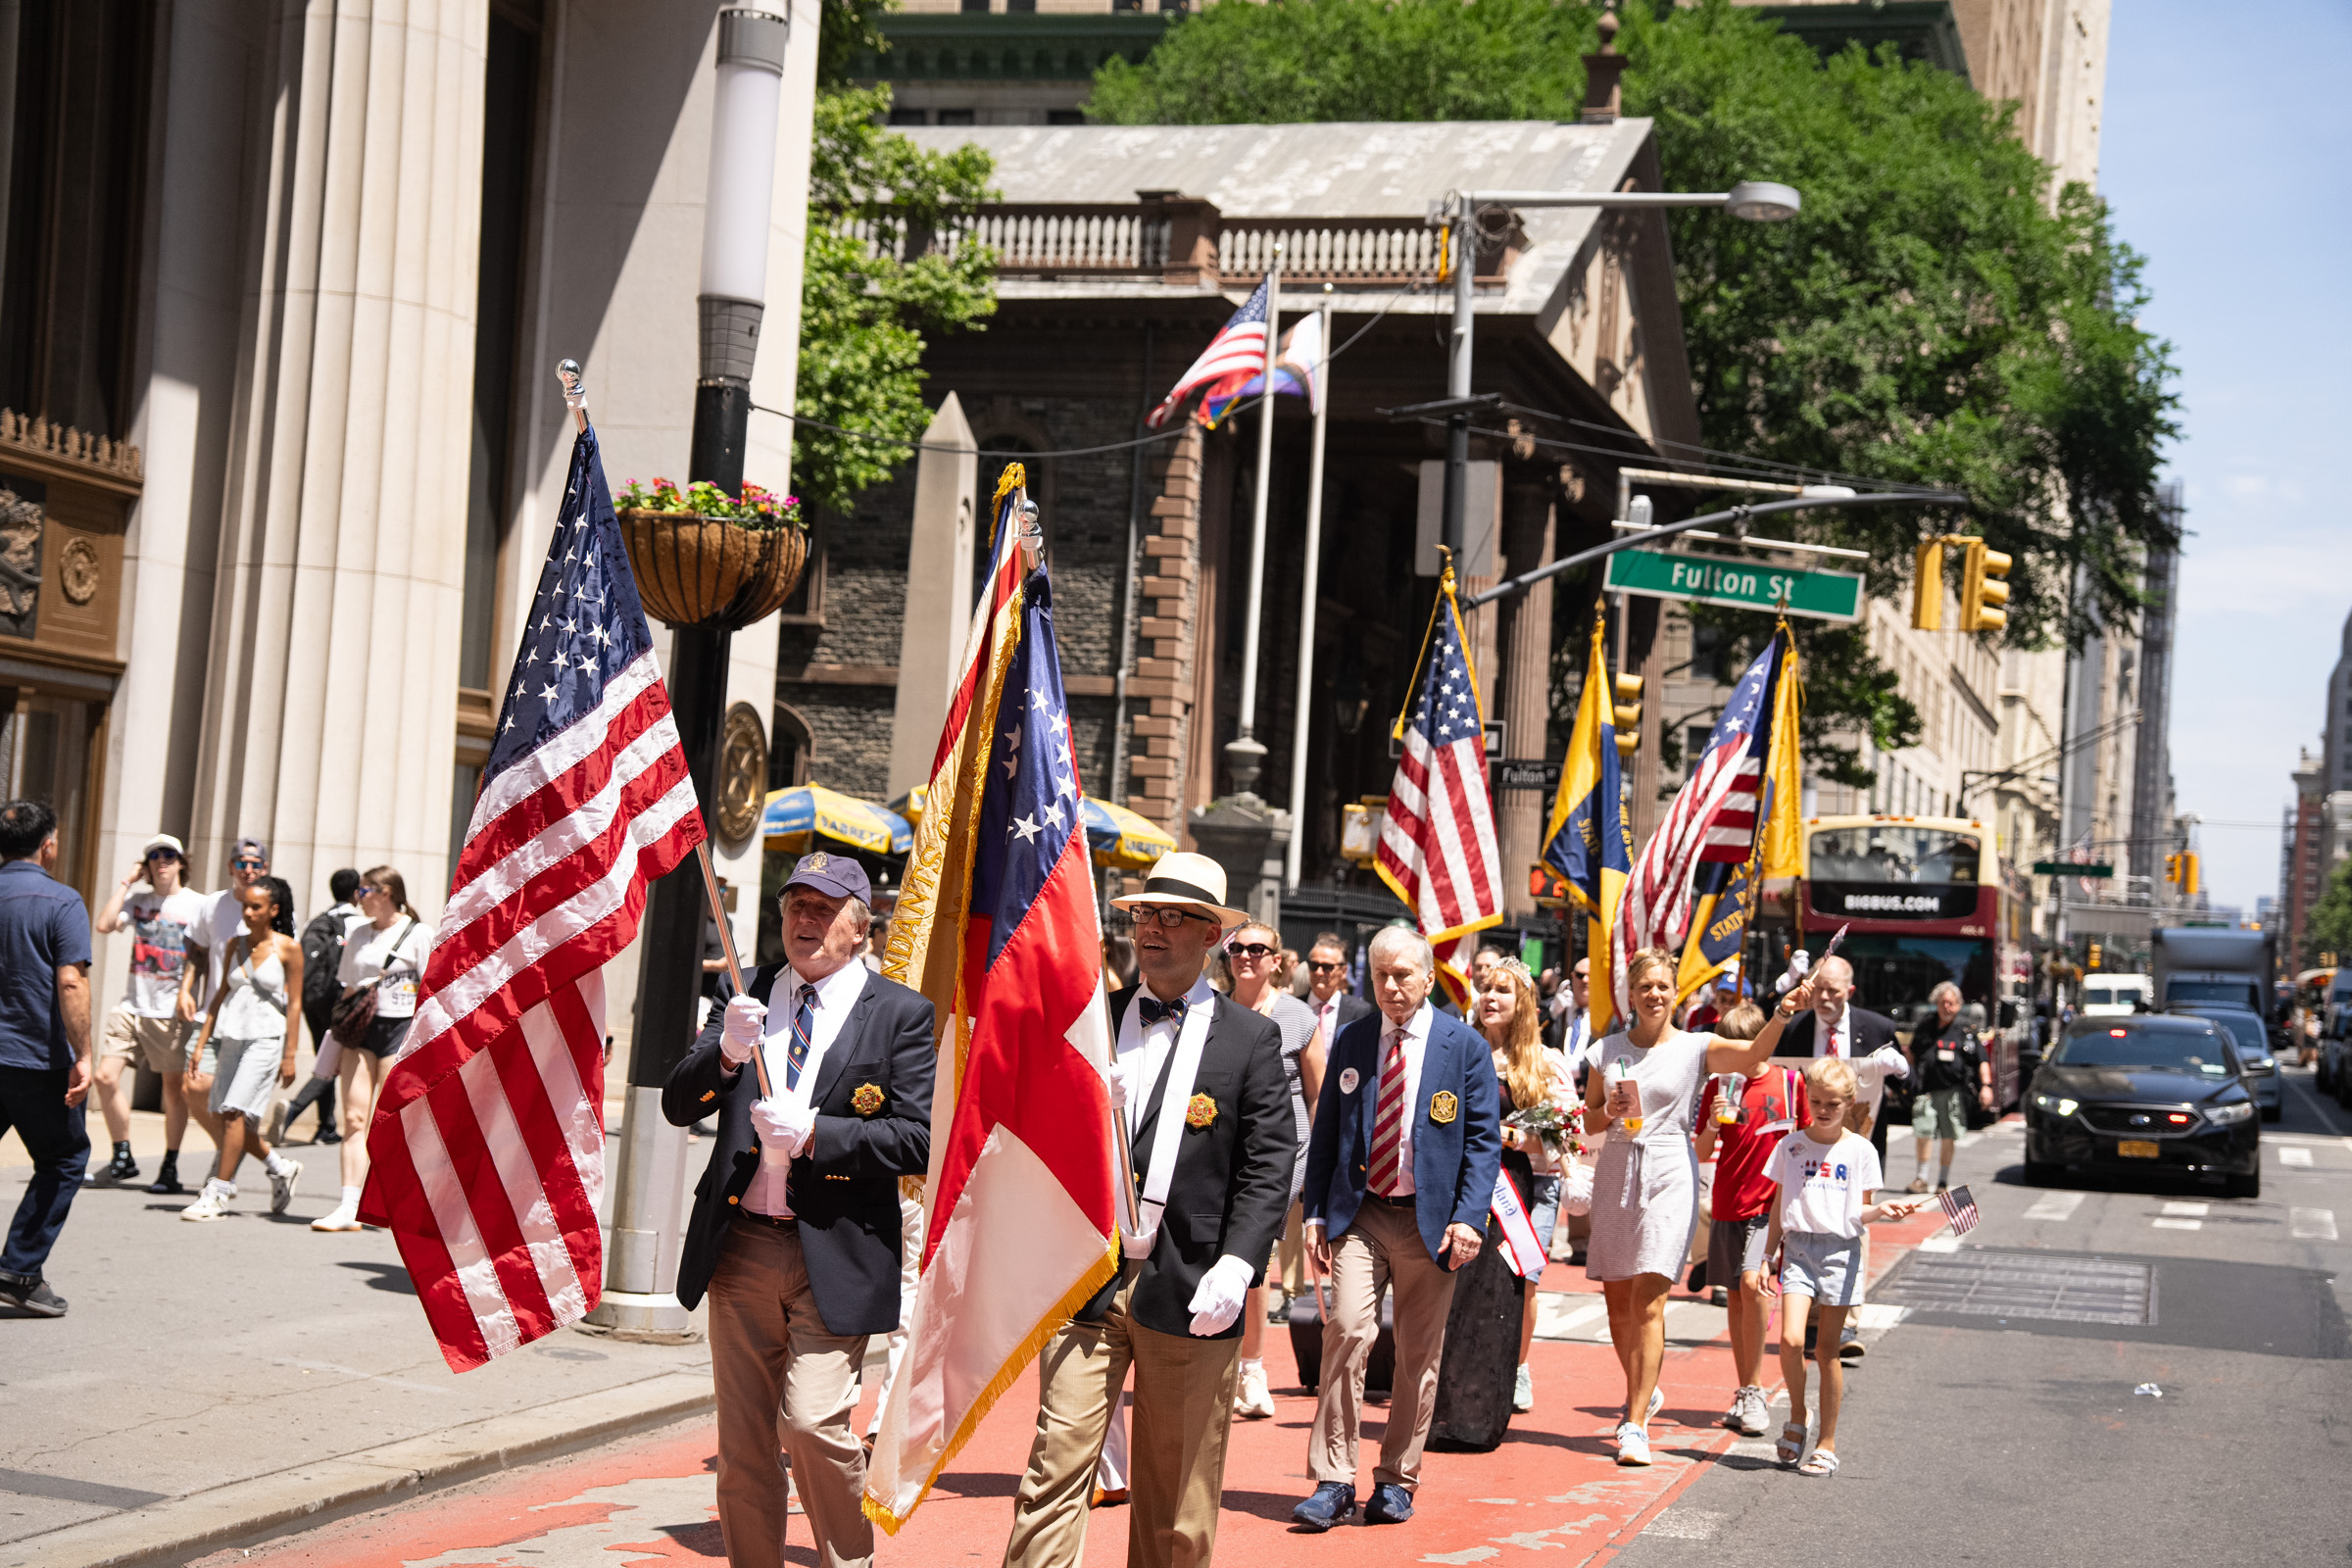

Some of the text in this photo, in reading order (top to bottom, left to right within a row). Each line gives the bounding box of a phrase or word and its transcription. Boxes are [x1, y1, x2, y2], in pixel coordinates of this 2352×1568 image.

[1671, 563, 1794, 602] Fulton St
[1502, 766, 1545, 783] Fulton
[821, 814, 885, 846] SABRETT
[1844, 894, 1939, 912] BIGBUS.COM
